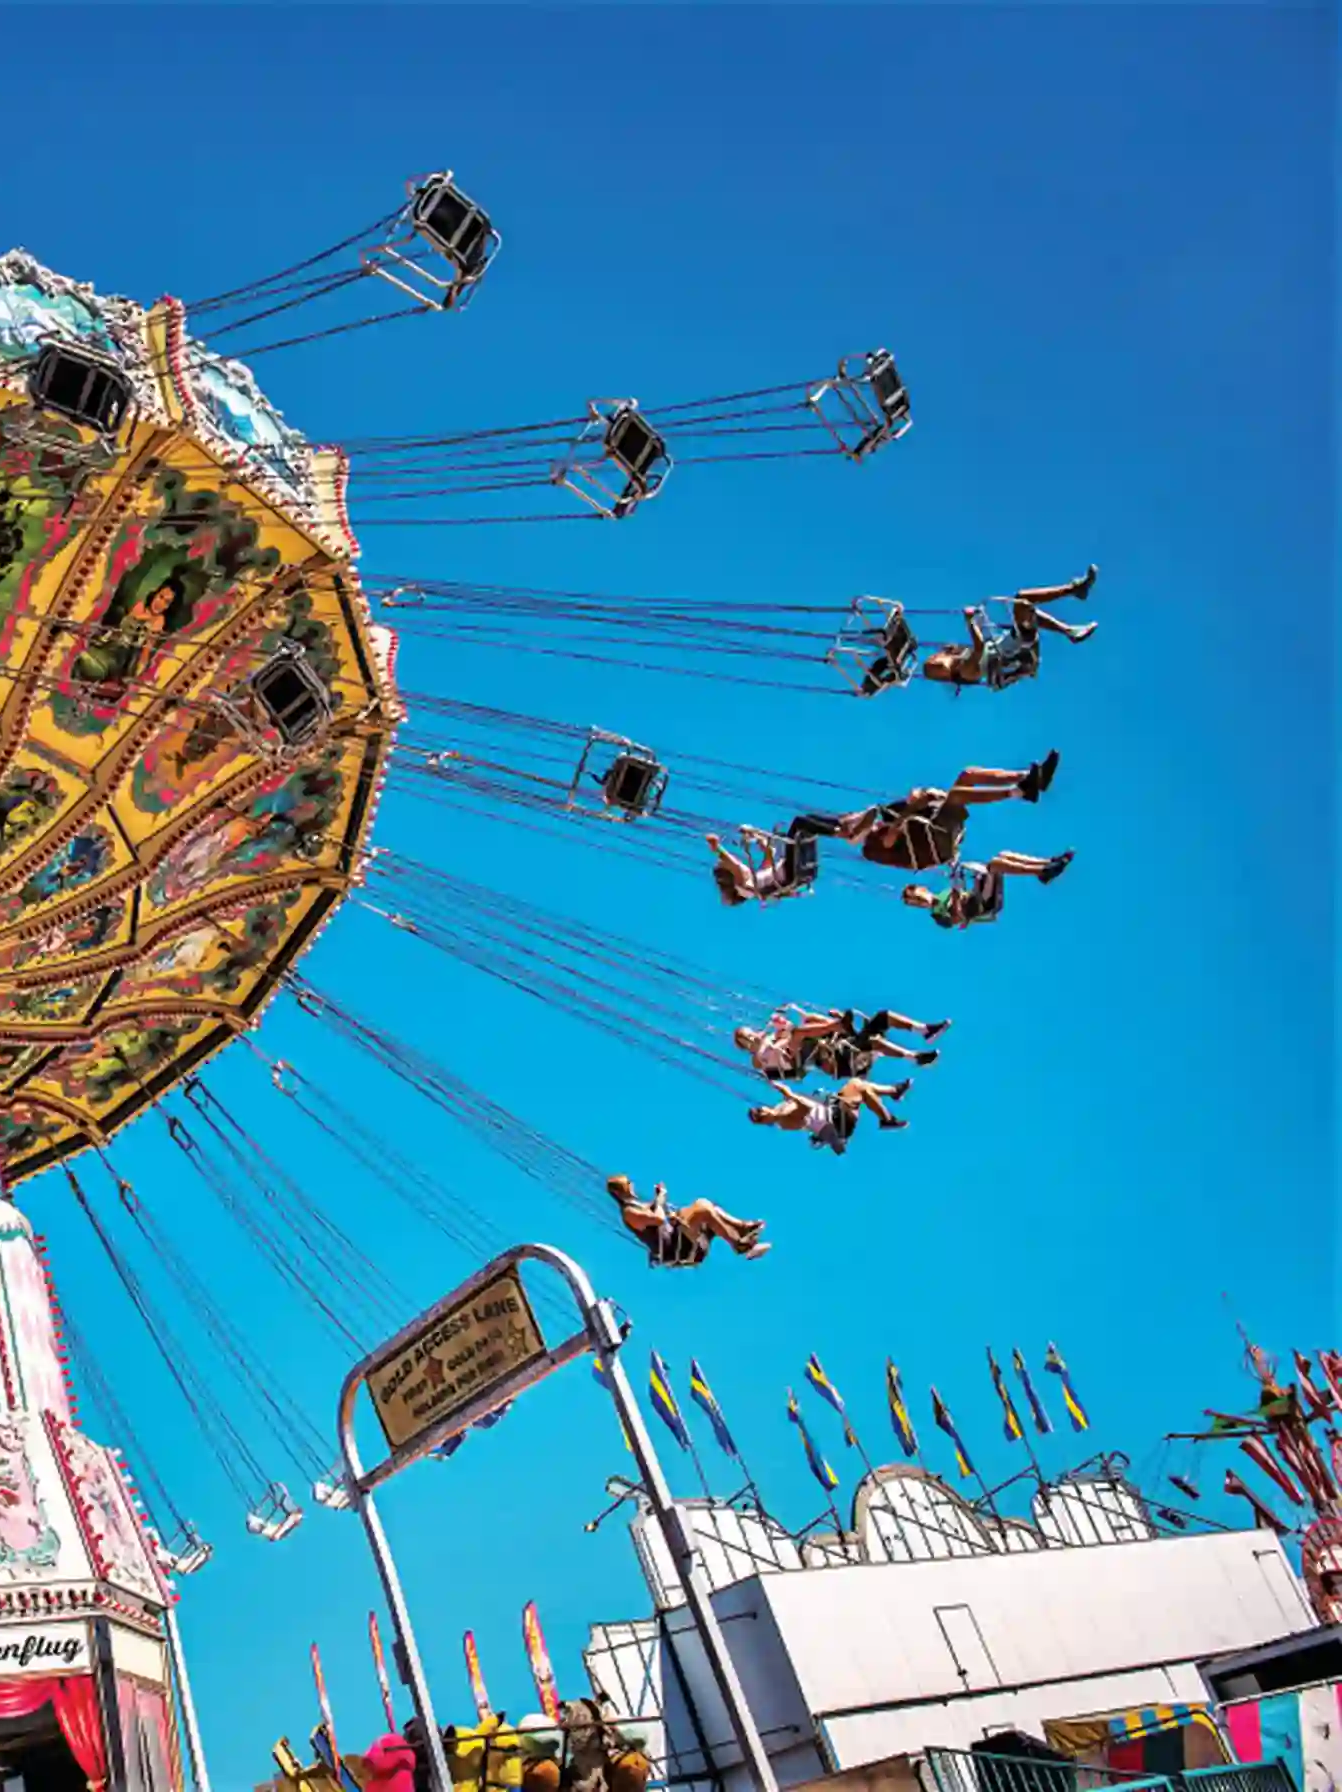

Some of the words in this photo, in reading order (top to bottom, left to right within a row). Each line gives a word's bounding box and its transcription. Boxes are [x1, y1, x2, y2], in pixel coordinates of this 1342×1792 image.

[380, 1359, 413, 1404] GOLD
[414, 1313, 470, 1367] ACCESS
[473, 1297, 520, 1322] LANE
